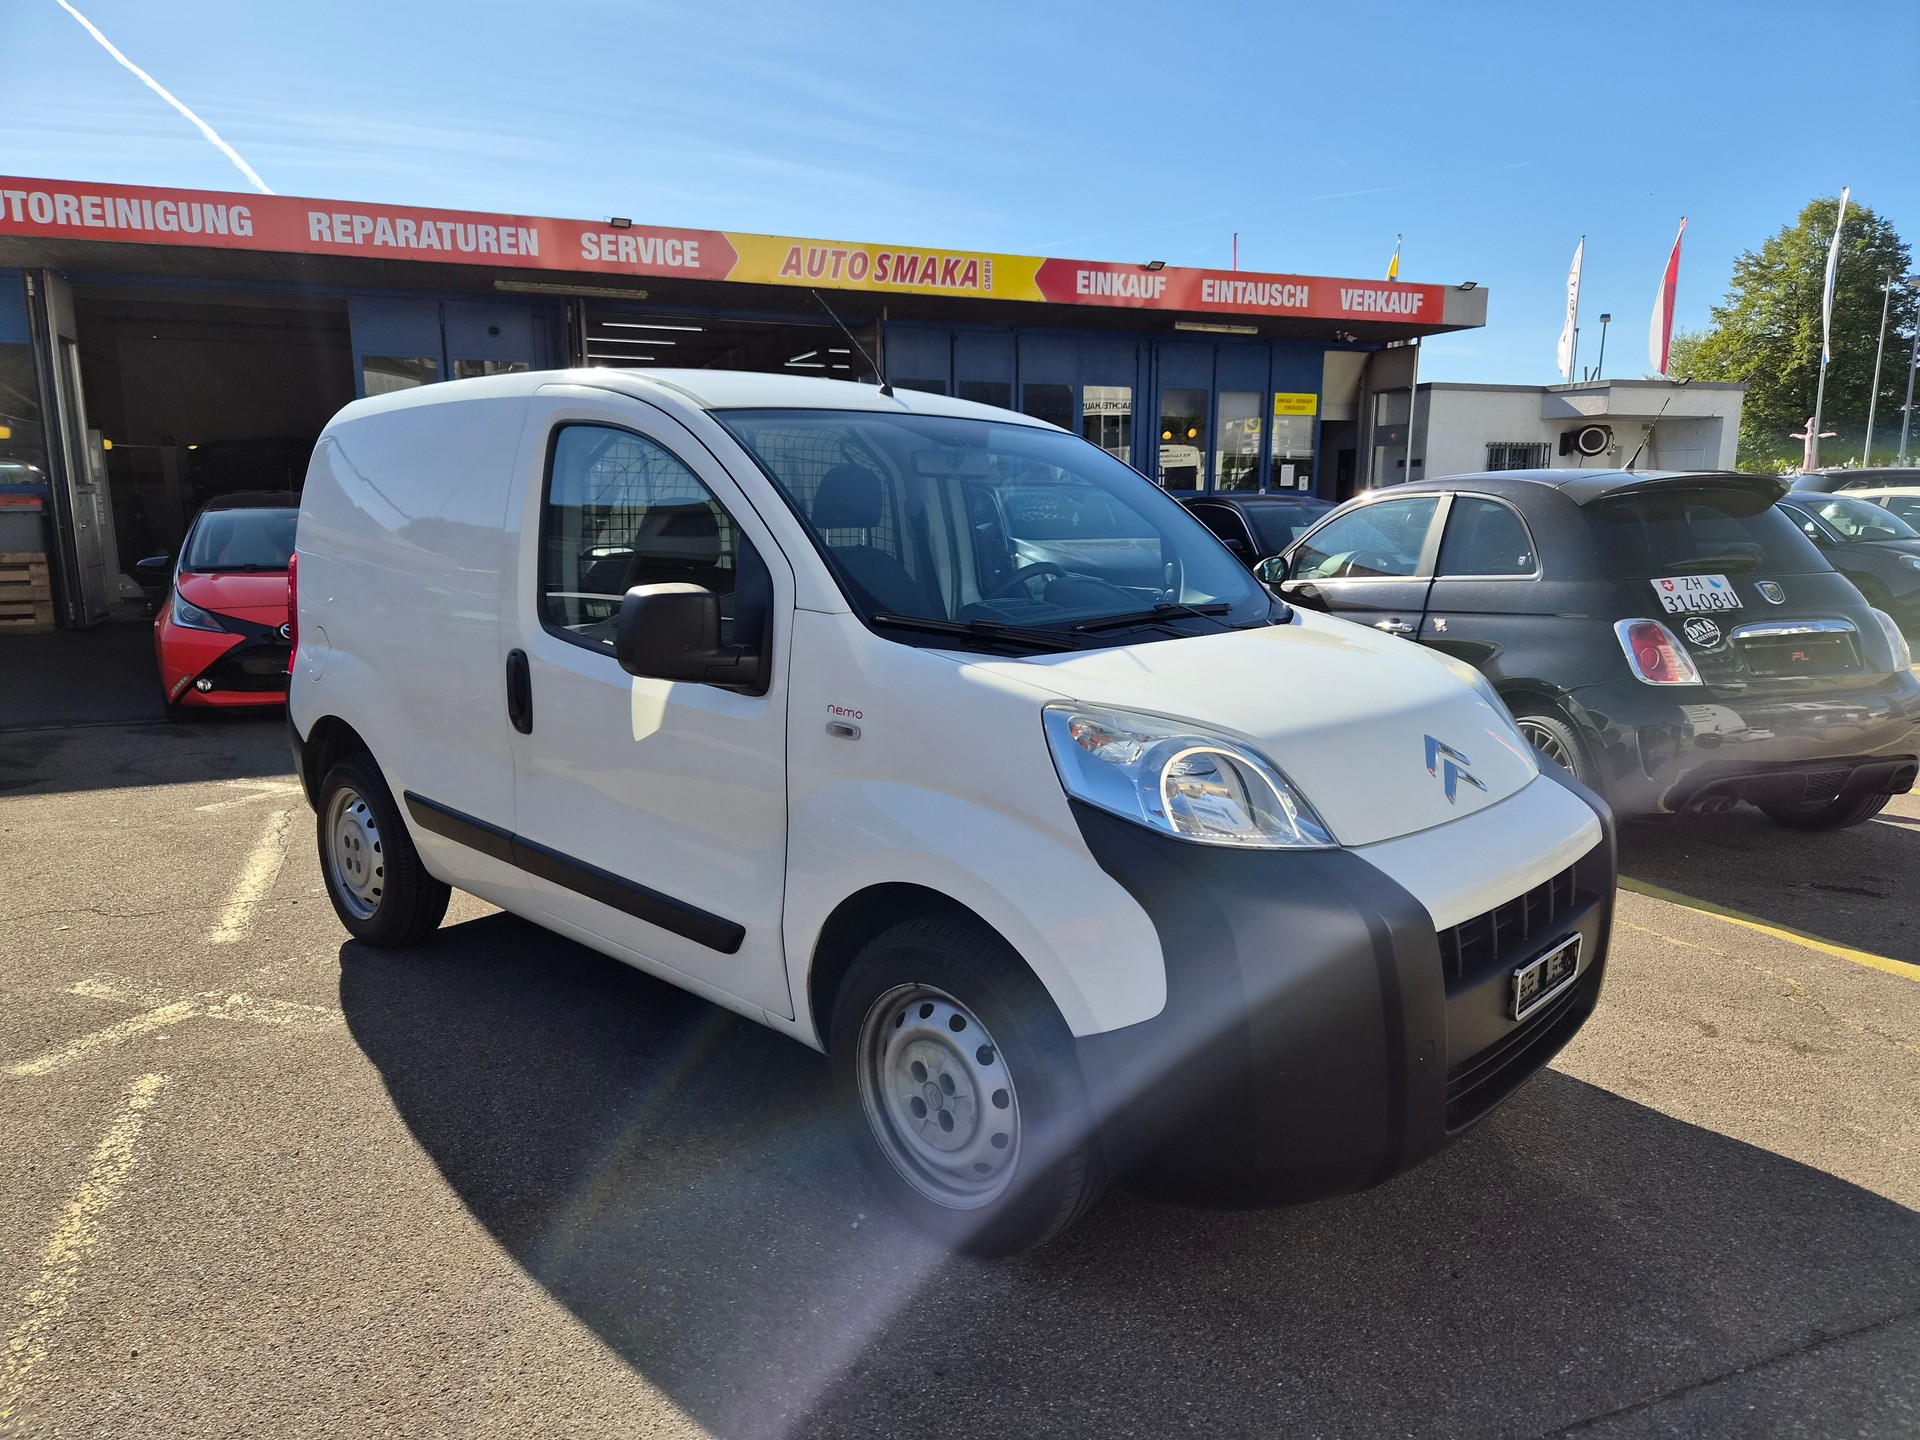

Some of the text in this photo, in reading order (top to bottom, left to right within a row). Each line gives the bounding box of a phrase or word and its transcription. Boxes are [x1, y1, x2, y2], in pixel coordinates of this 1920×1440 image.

[0, 189, 253, 237] TOREINIGUNG
[308, 212, 539, 256] REPARATUREN
[581, 232, 700, 268] SERVICE
[779, 245, 992, 291] AUTO SMAKA GMBH
[1076, 270, 1167, 299] EINKAUF
[1201, 279, 1309, 308] EINTAUSCH
[1340, 288, 1424, 315] VERKAUF
[1681, 577, 1704, 591] ZH
[1686, 620, 1716, 639] DNA
[826, 704, 863, 720] nemo
